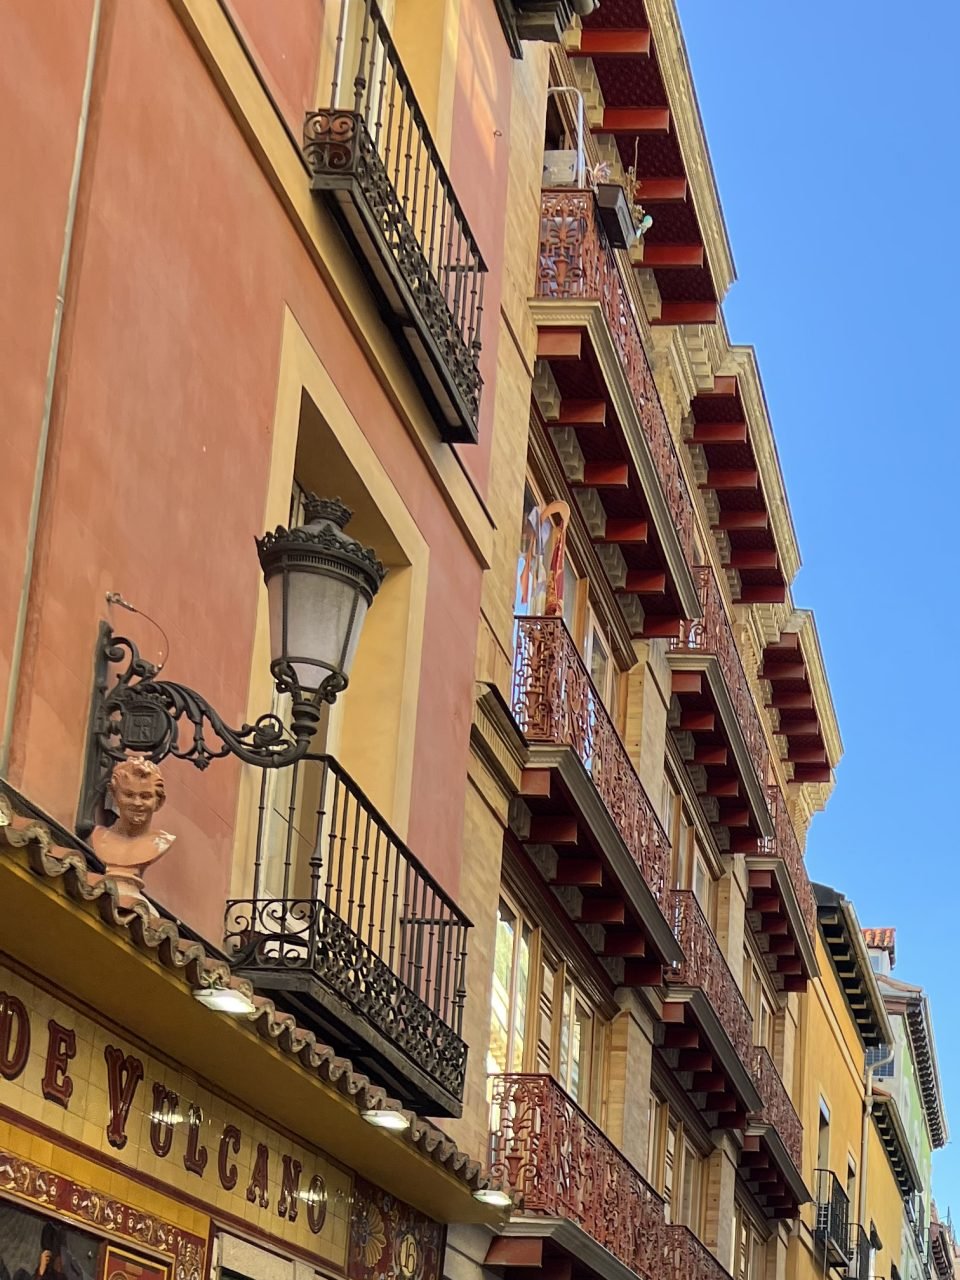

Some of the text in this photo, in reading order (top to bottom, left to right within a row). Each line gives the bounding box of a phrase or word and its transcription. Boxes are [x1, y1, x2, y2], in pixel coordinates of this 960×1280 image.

[0, 990, 328, 1235] DE VULCANO
[402, 1236, 416, 1274] 16
